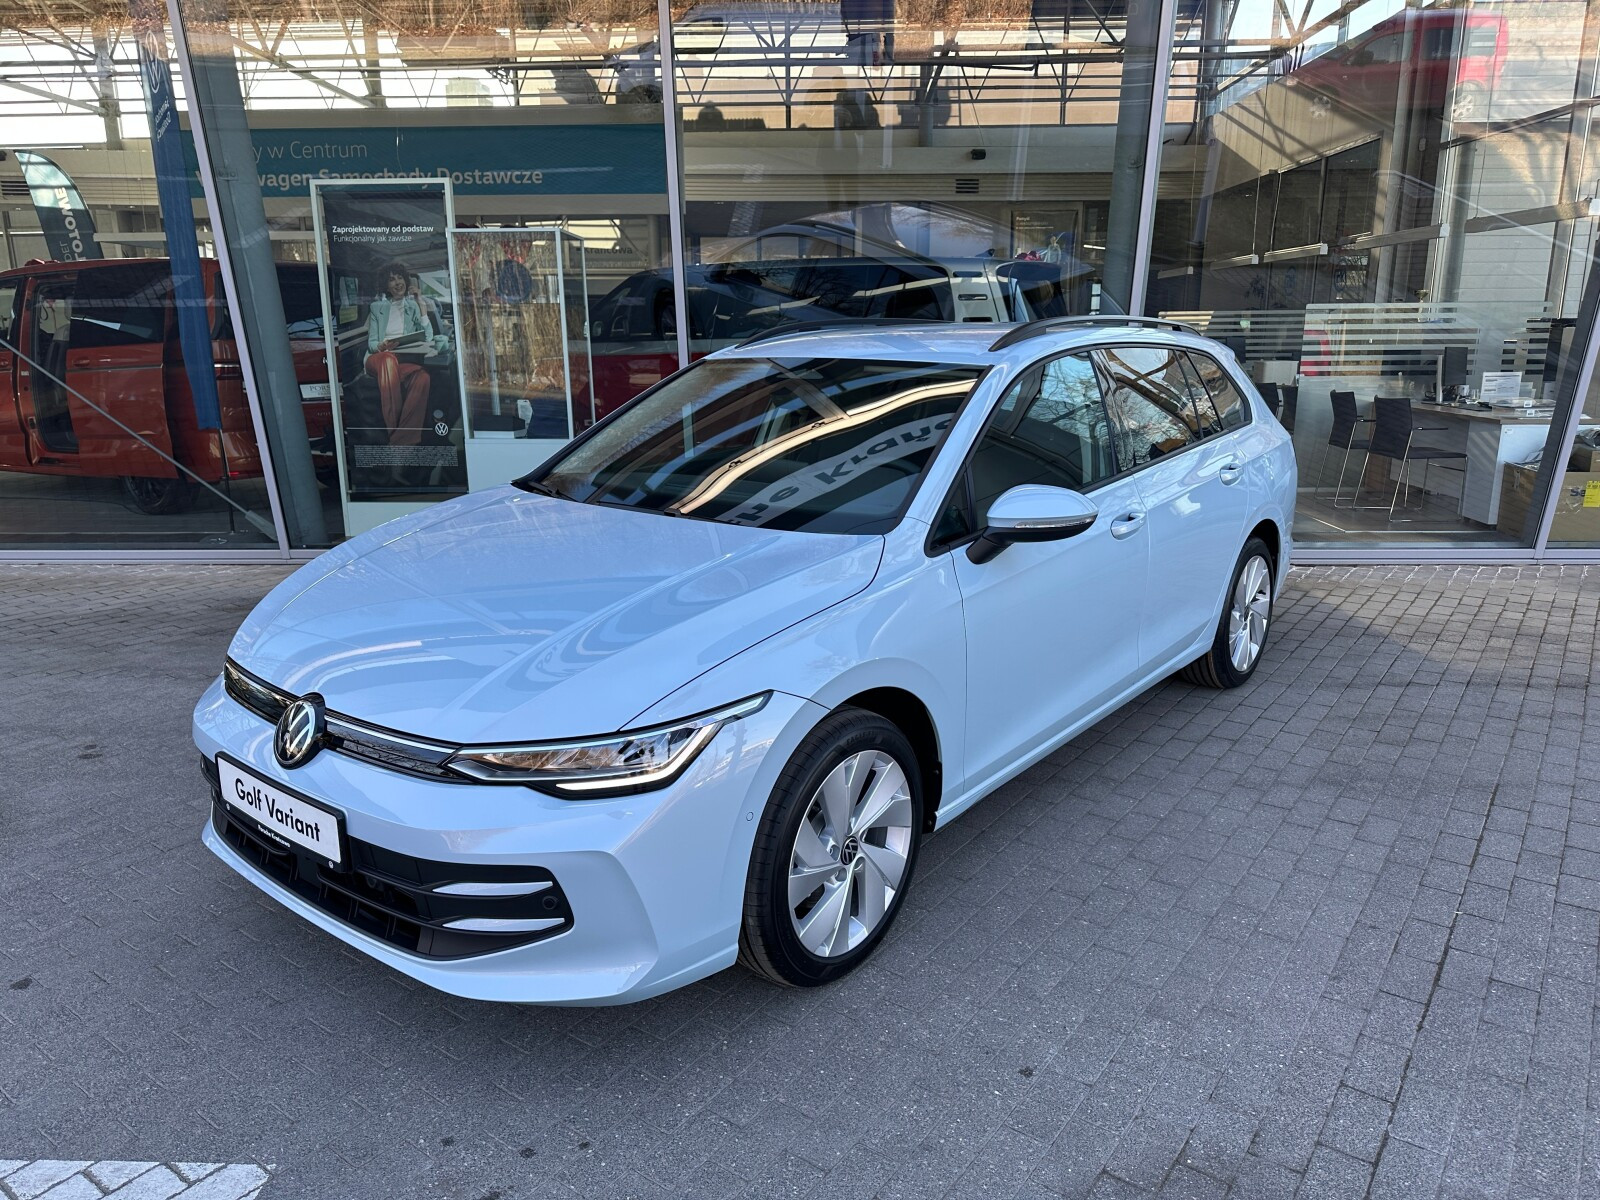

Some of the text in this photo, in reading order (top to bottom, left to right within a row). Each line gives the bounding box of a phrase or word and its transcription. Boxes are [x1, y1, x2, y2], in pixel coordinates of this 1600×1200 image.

[290, 140, 367, 159] Centrum
[257, 172, 311, 191] wagen
[436, 167, 543, 185] Dostawcze
[332, 224, 434, 235] Zaprojektowany od podstaw
[333, 234, 375, 244] Funkcjonalny
[376, 234, 386, 243] jak
[235, 777, 262, 812] Golf
[264, 793, 321, 842] Variant
